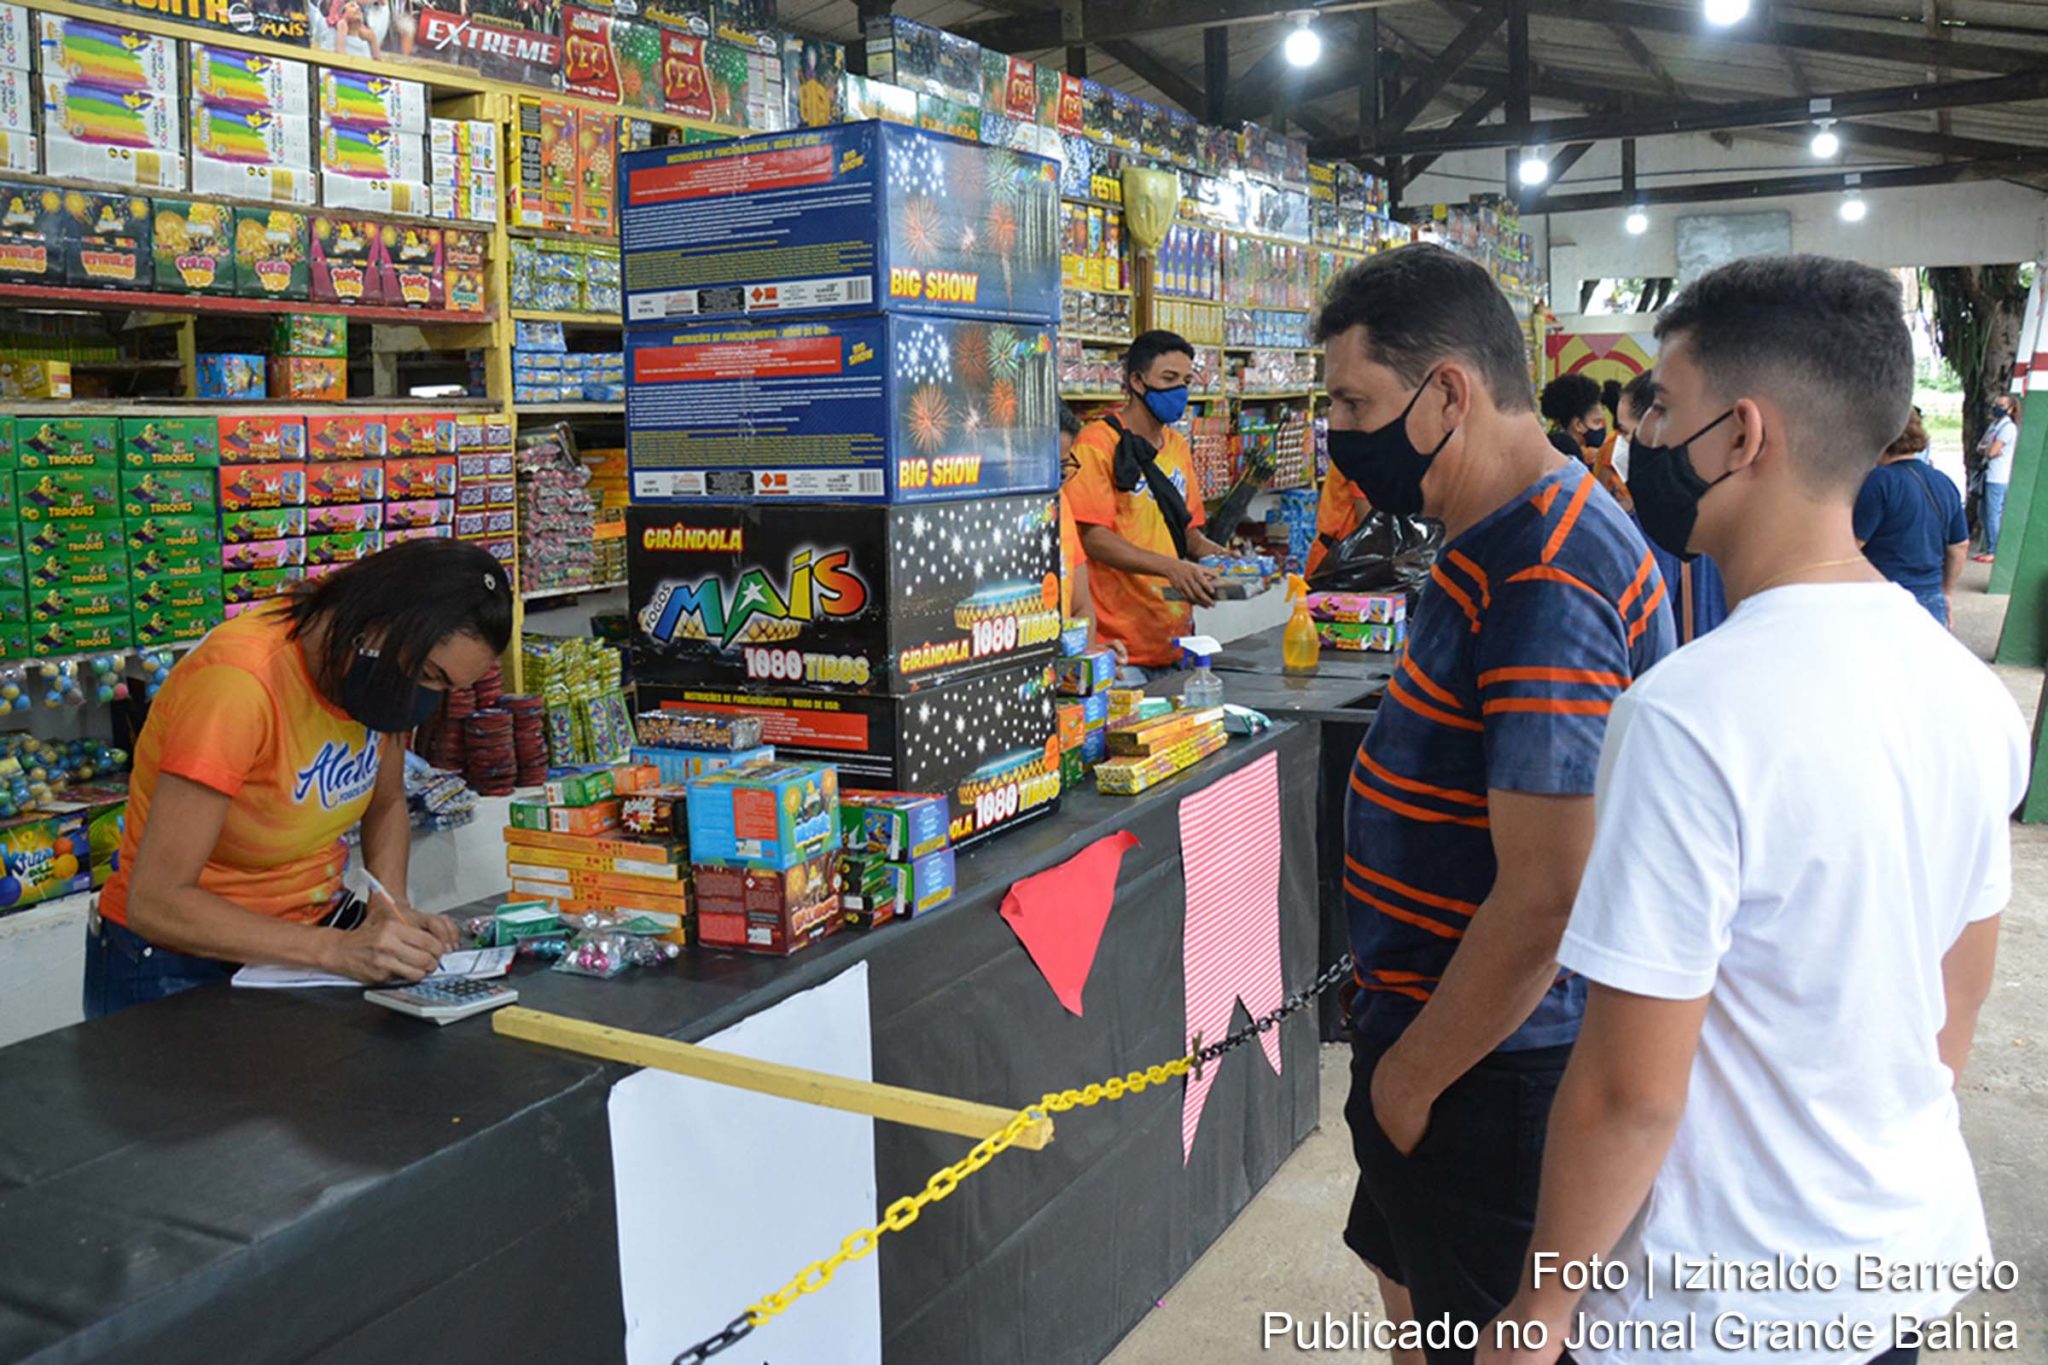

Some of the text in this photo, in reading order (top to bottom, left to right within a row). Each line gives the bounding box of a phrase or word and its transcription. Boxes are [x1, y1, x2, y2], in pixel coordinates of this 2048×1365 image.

[262, 21, 304, 37] MAIS
[427, 19, 556, 64] EXTREME
[890, 267, 922, 297] BIG
[925, 271, 978, 303] SHOW
[48, 453, 95, 466] TRAQUES
[152, 452, 195, 464] TRAQUES
[899, 457, 929, 489] BIG
[931, 454, 981, 487] SHOW
[48, 506, 95, 517] TRAQUES
[643, 522, 743, 551] GIRÂNDOLA
[646, 583, 672, 629] FOGOS
[651, 549, 867, 649] MAIS
[901, 639, 969, 673] GIRÂNDOLA
[972, 615, 1016, 657] 1080
[1018, 611, 1060, 647] TIROS
[744, 648, 802, 680] 1080
[803, 652, 870, 684] TIROS
[976, 783, 1018, 830] 1080
[1019, 772, 1060, 812] TIROS
